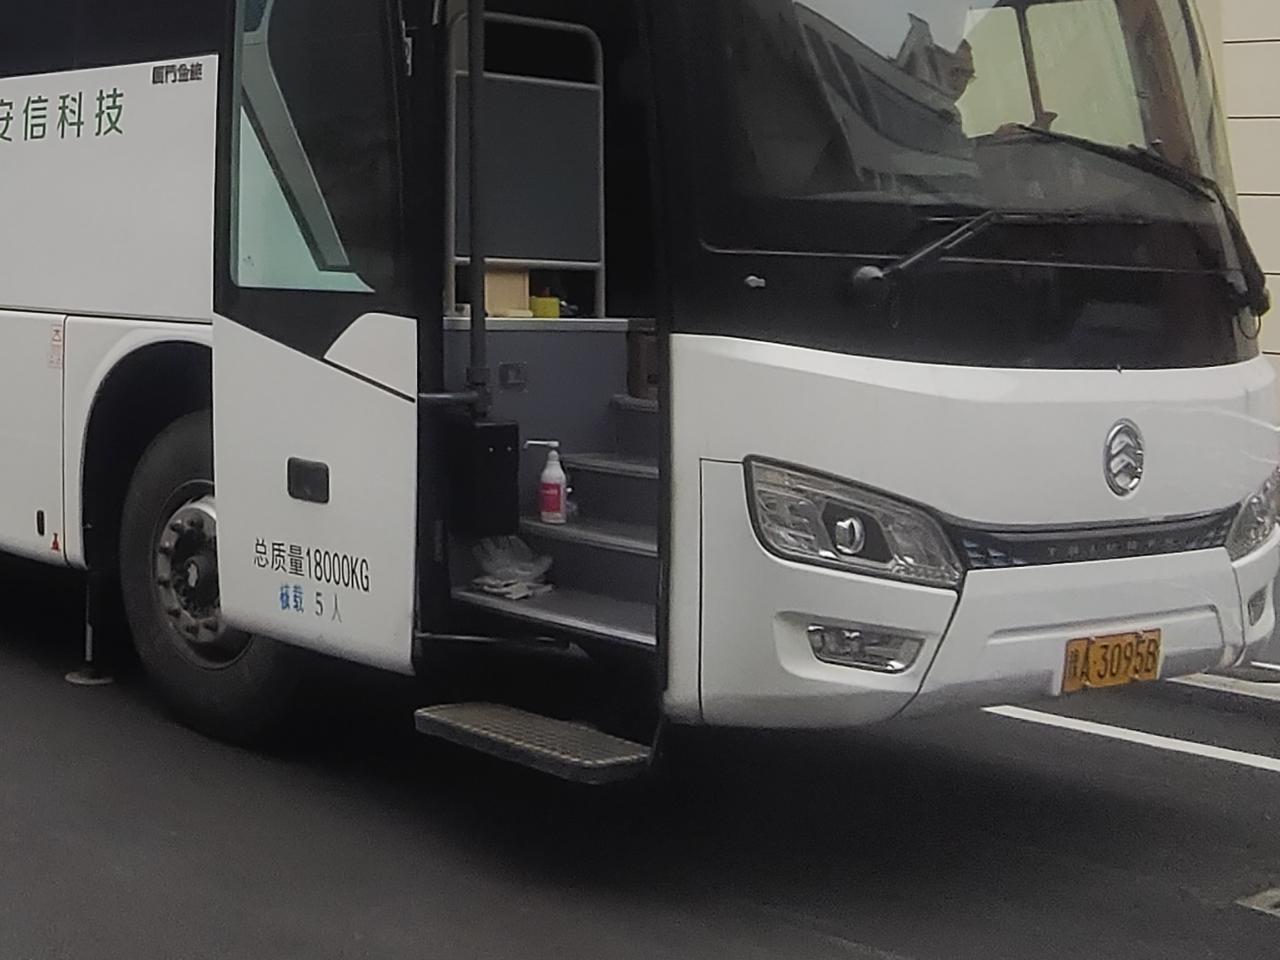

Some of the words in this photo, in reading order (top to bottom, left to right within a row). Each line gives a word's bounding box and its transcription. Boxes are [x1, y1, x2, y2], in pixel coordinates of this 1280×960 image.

[253, 538, 370, 593] 总质量18000KG
[314, 591, 324, 617] 5
[331, 593, 343, 624] 人
